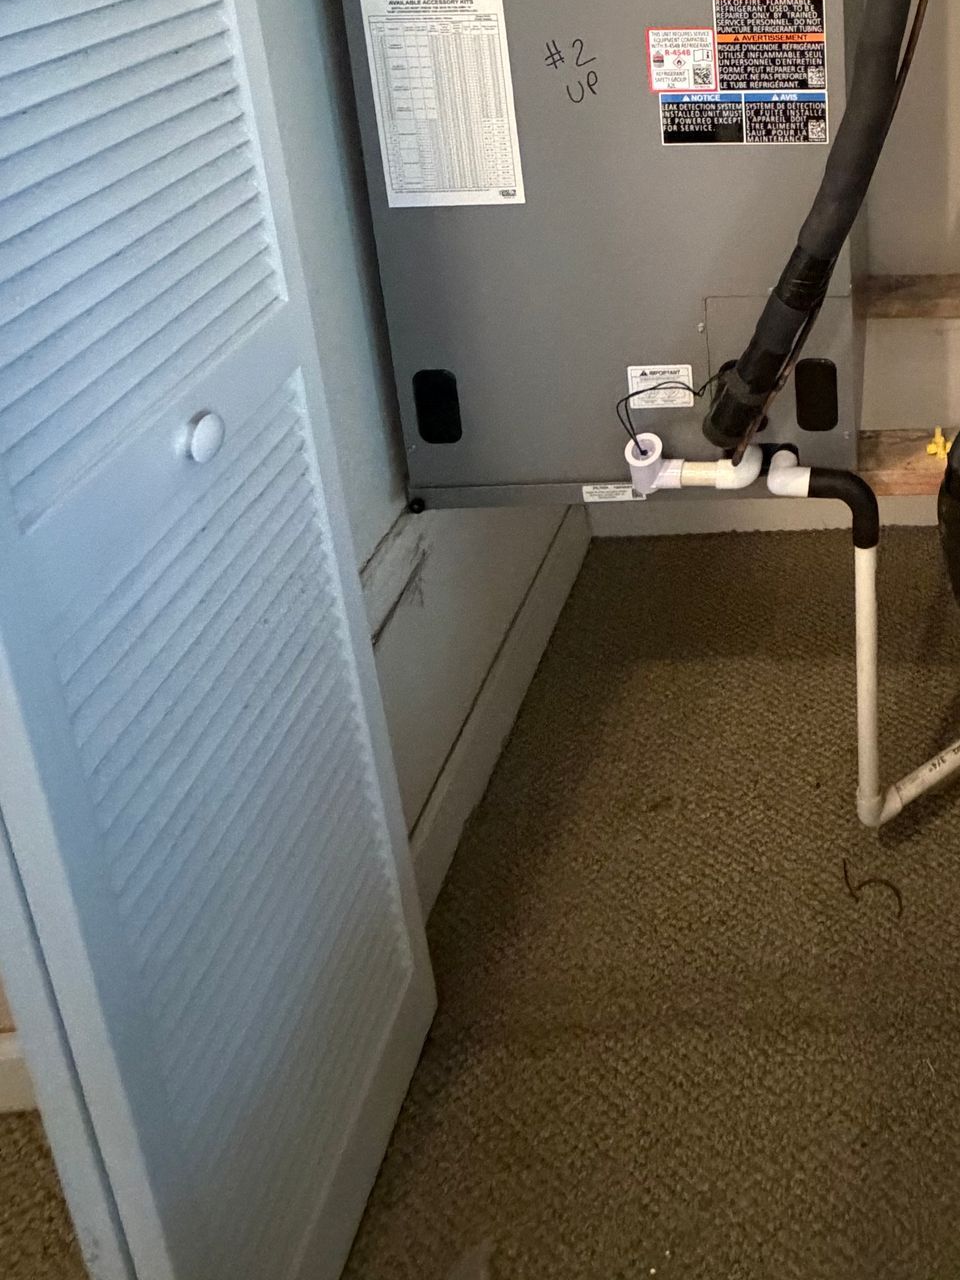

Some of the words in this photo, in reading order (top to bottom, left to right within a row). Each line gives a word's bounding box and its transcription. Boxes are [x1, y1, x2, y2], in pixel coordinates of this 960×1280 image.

[566, 70, 598, 103] UP
[702, 110, 720, 118] UNIT
[663, 117, 673, 125] BE
[674, 117, 712, 125] POWERED
